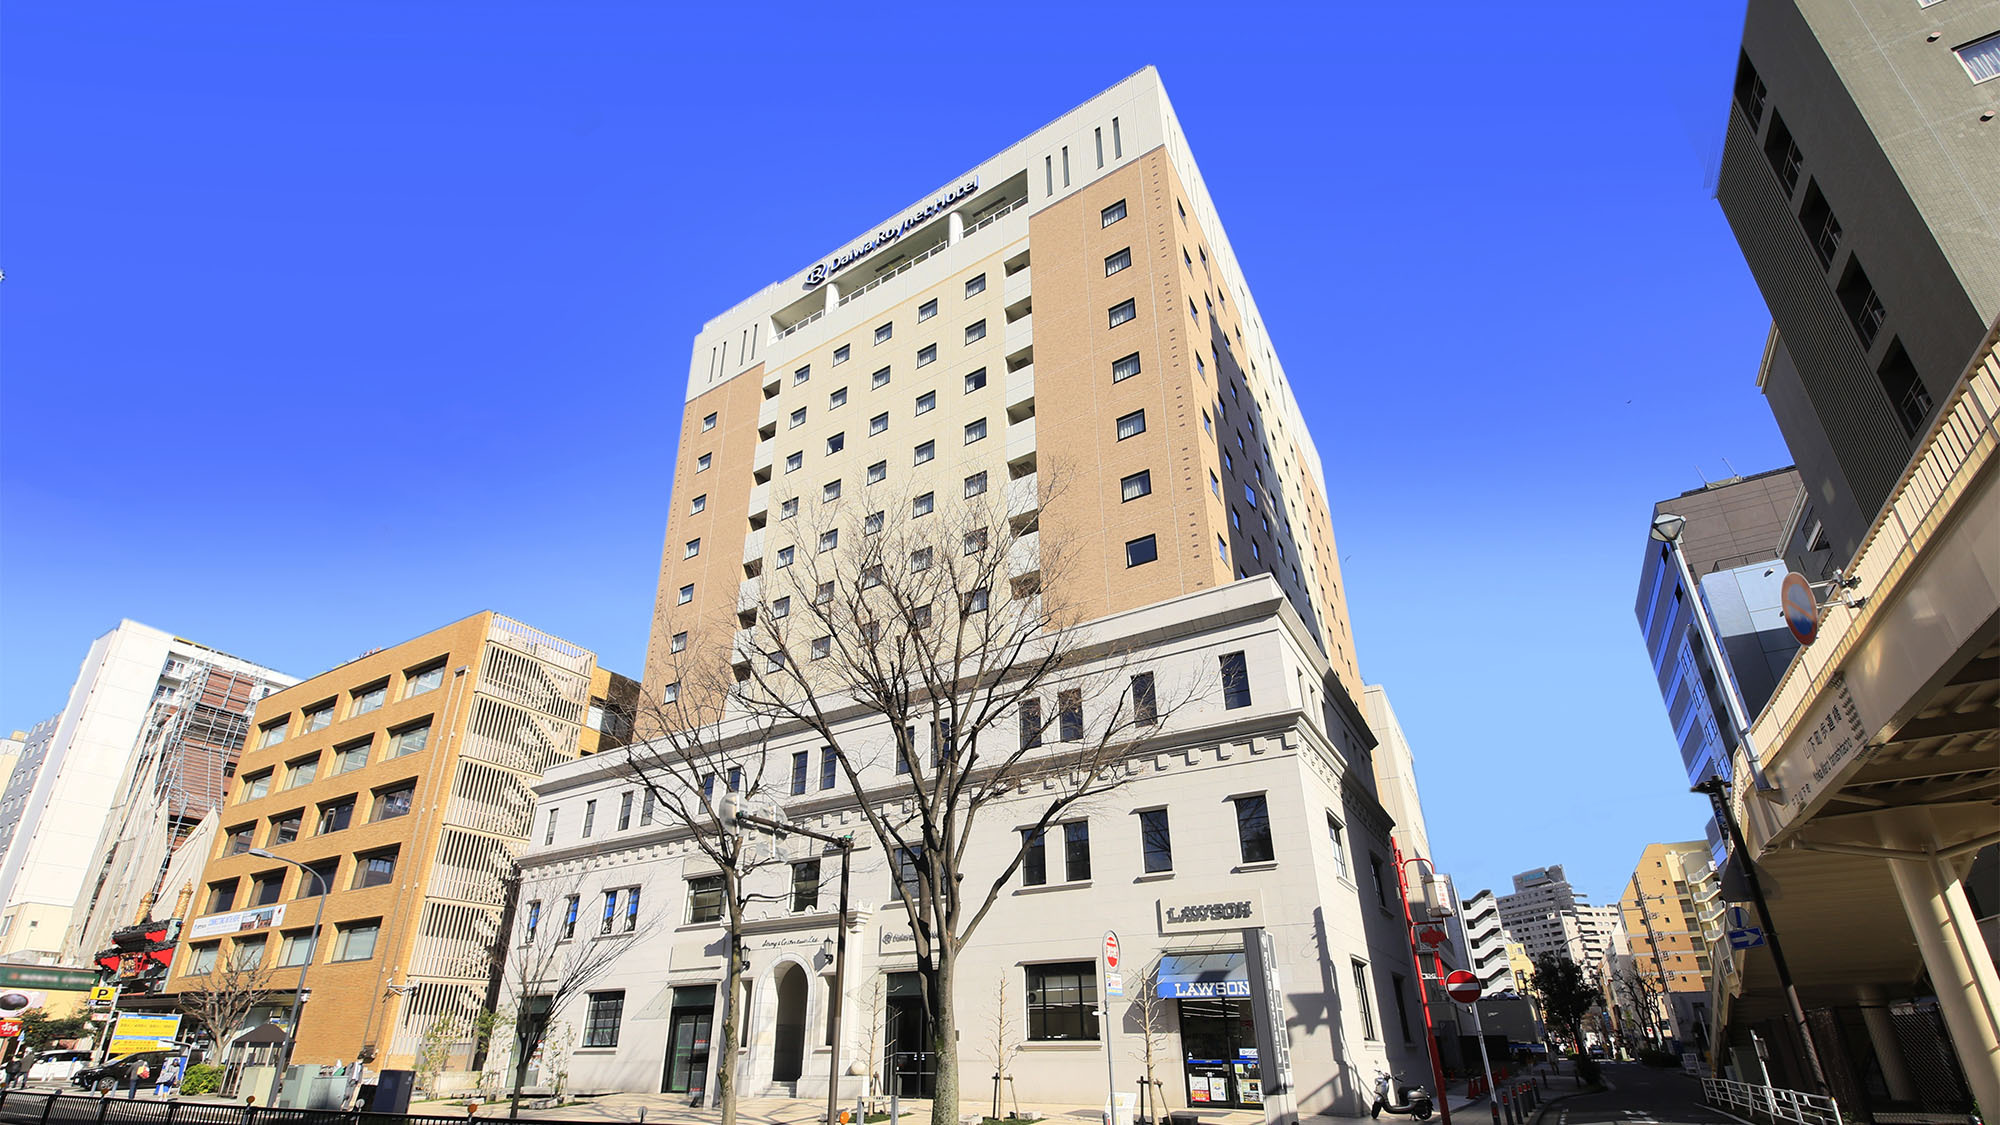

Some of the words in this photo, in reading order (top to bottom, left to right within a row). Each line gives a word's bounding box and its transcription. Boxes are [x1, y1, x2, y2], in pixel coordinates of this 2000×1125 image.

[830, 239, 874, 272] Daiwa
[875, 205, 934, 246] Roynet
[933, 175, 980, 213] Hotel
[1803, 704, 1842, 759] 山下町歩道橋
[1166, 901, 1252, 924] LAWSON
[97, 989, 109, 999] P
[1174, 981, 1251, 997] LAWSON
